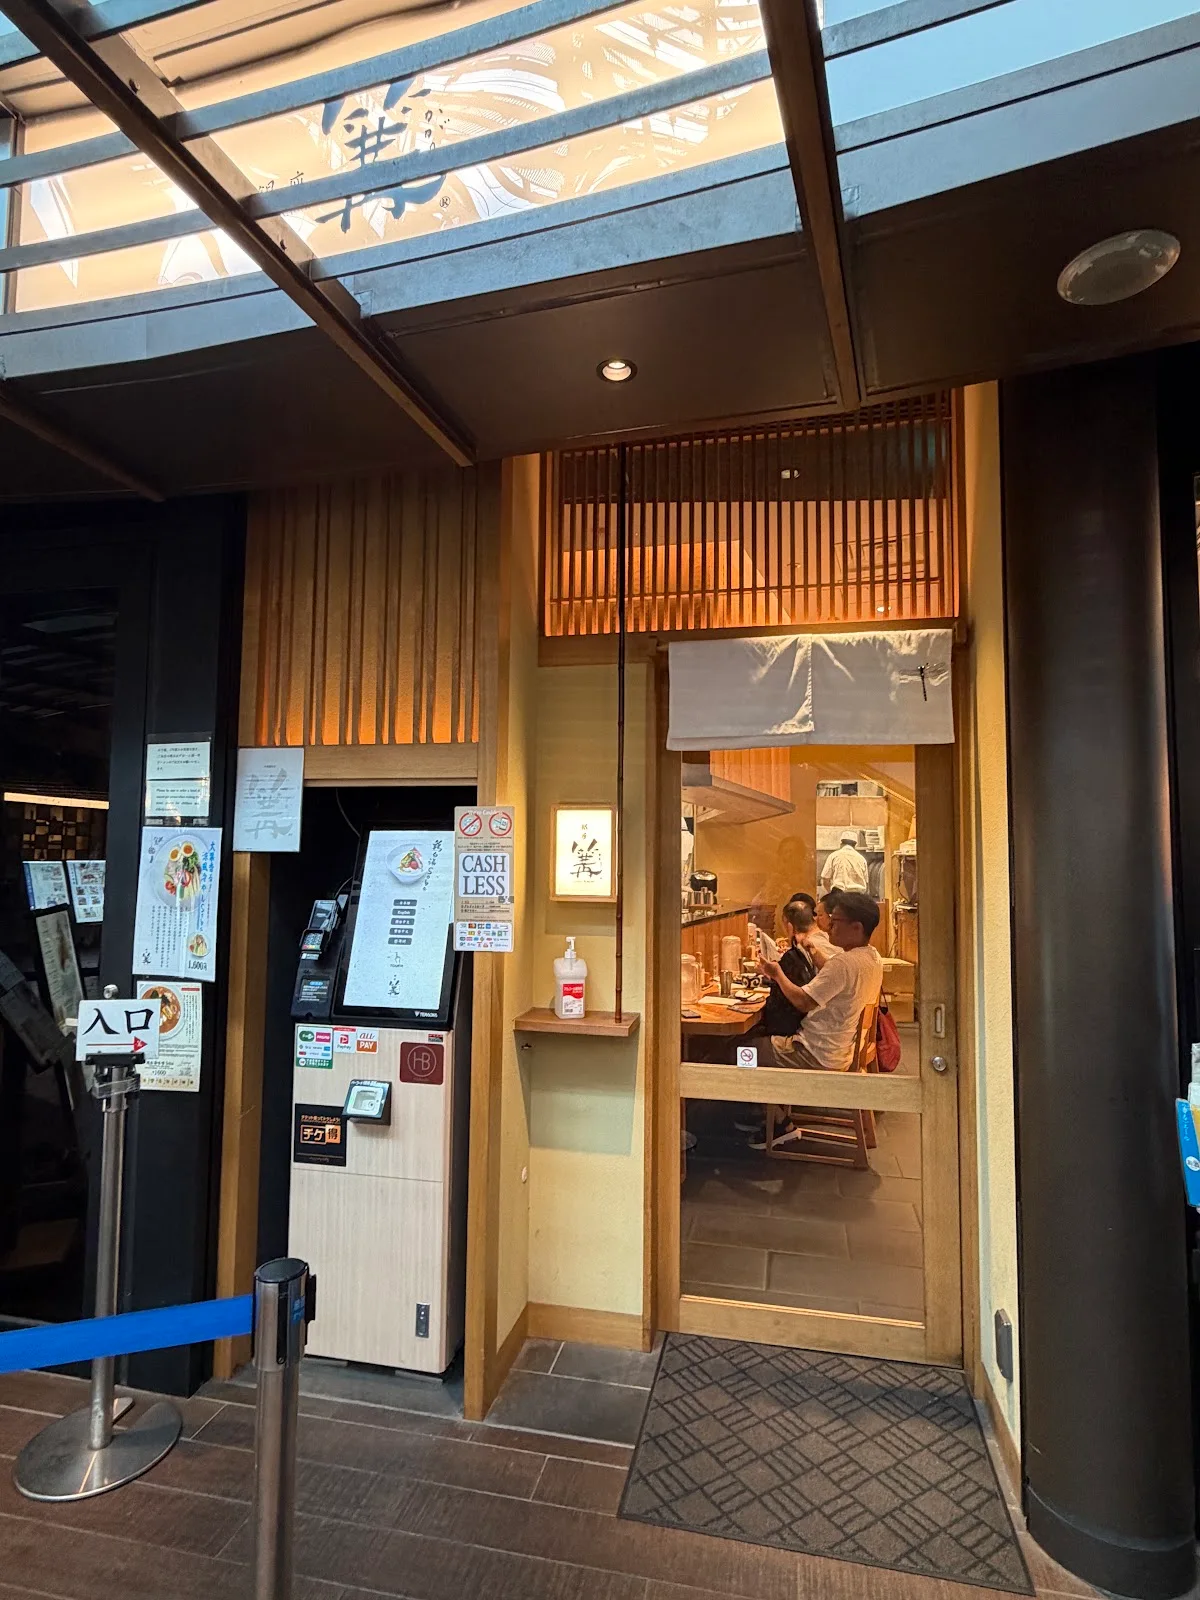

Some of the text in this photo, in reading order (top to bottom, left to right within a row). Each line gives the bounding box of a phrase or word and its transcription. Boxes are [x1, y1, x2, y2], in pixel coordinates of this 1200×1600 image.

[462, 855, 506, 872] CASH
[463, 876, 505, 895] LESS
[82, 1008, 154, 1035] 入口
[359, 1041, 373, 1049] PAY
[303, 1128, 338, 1141] チケ得
